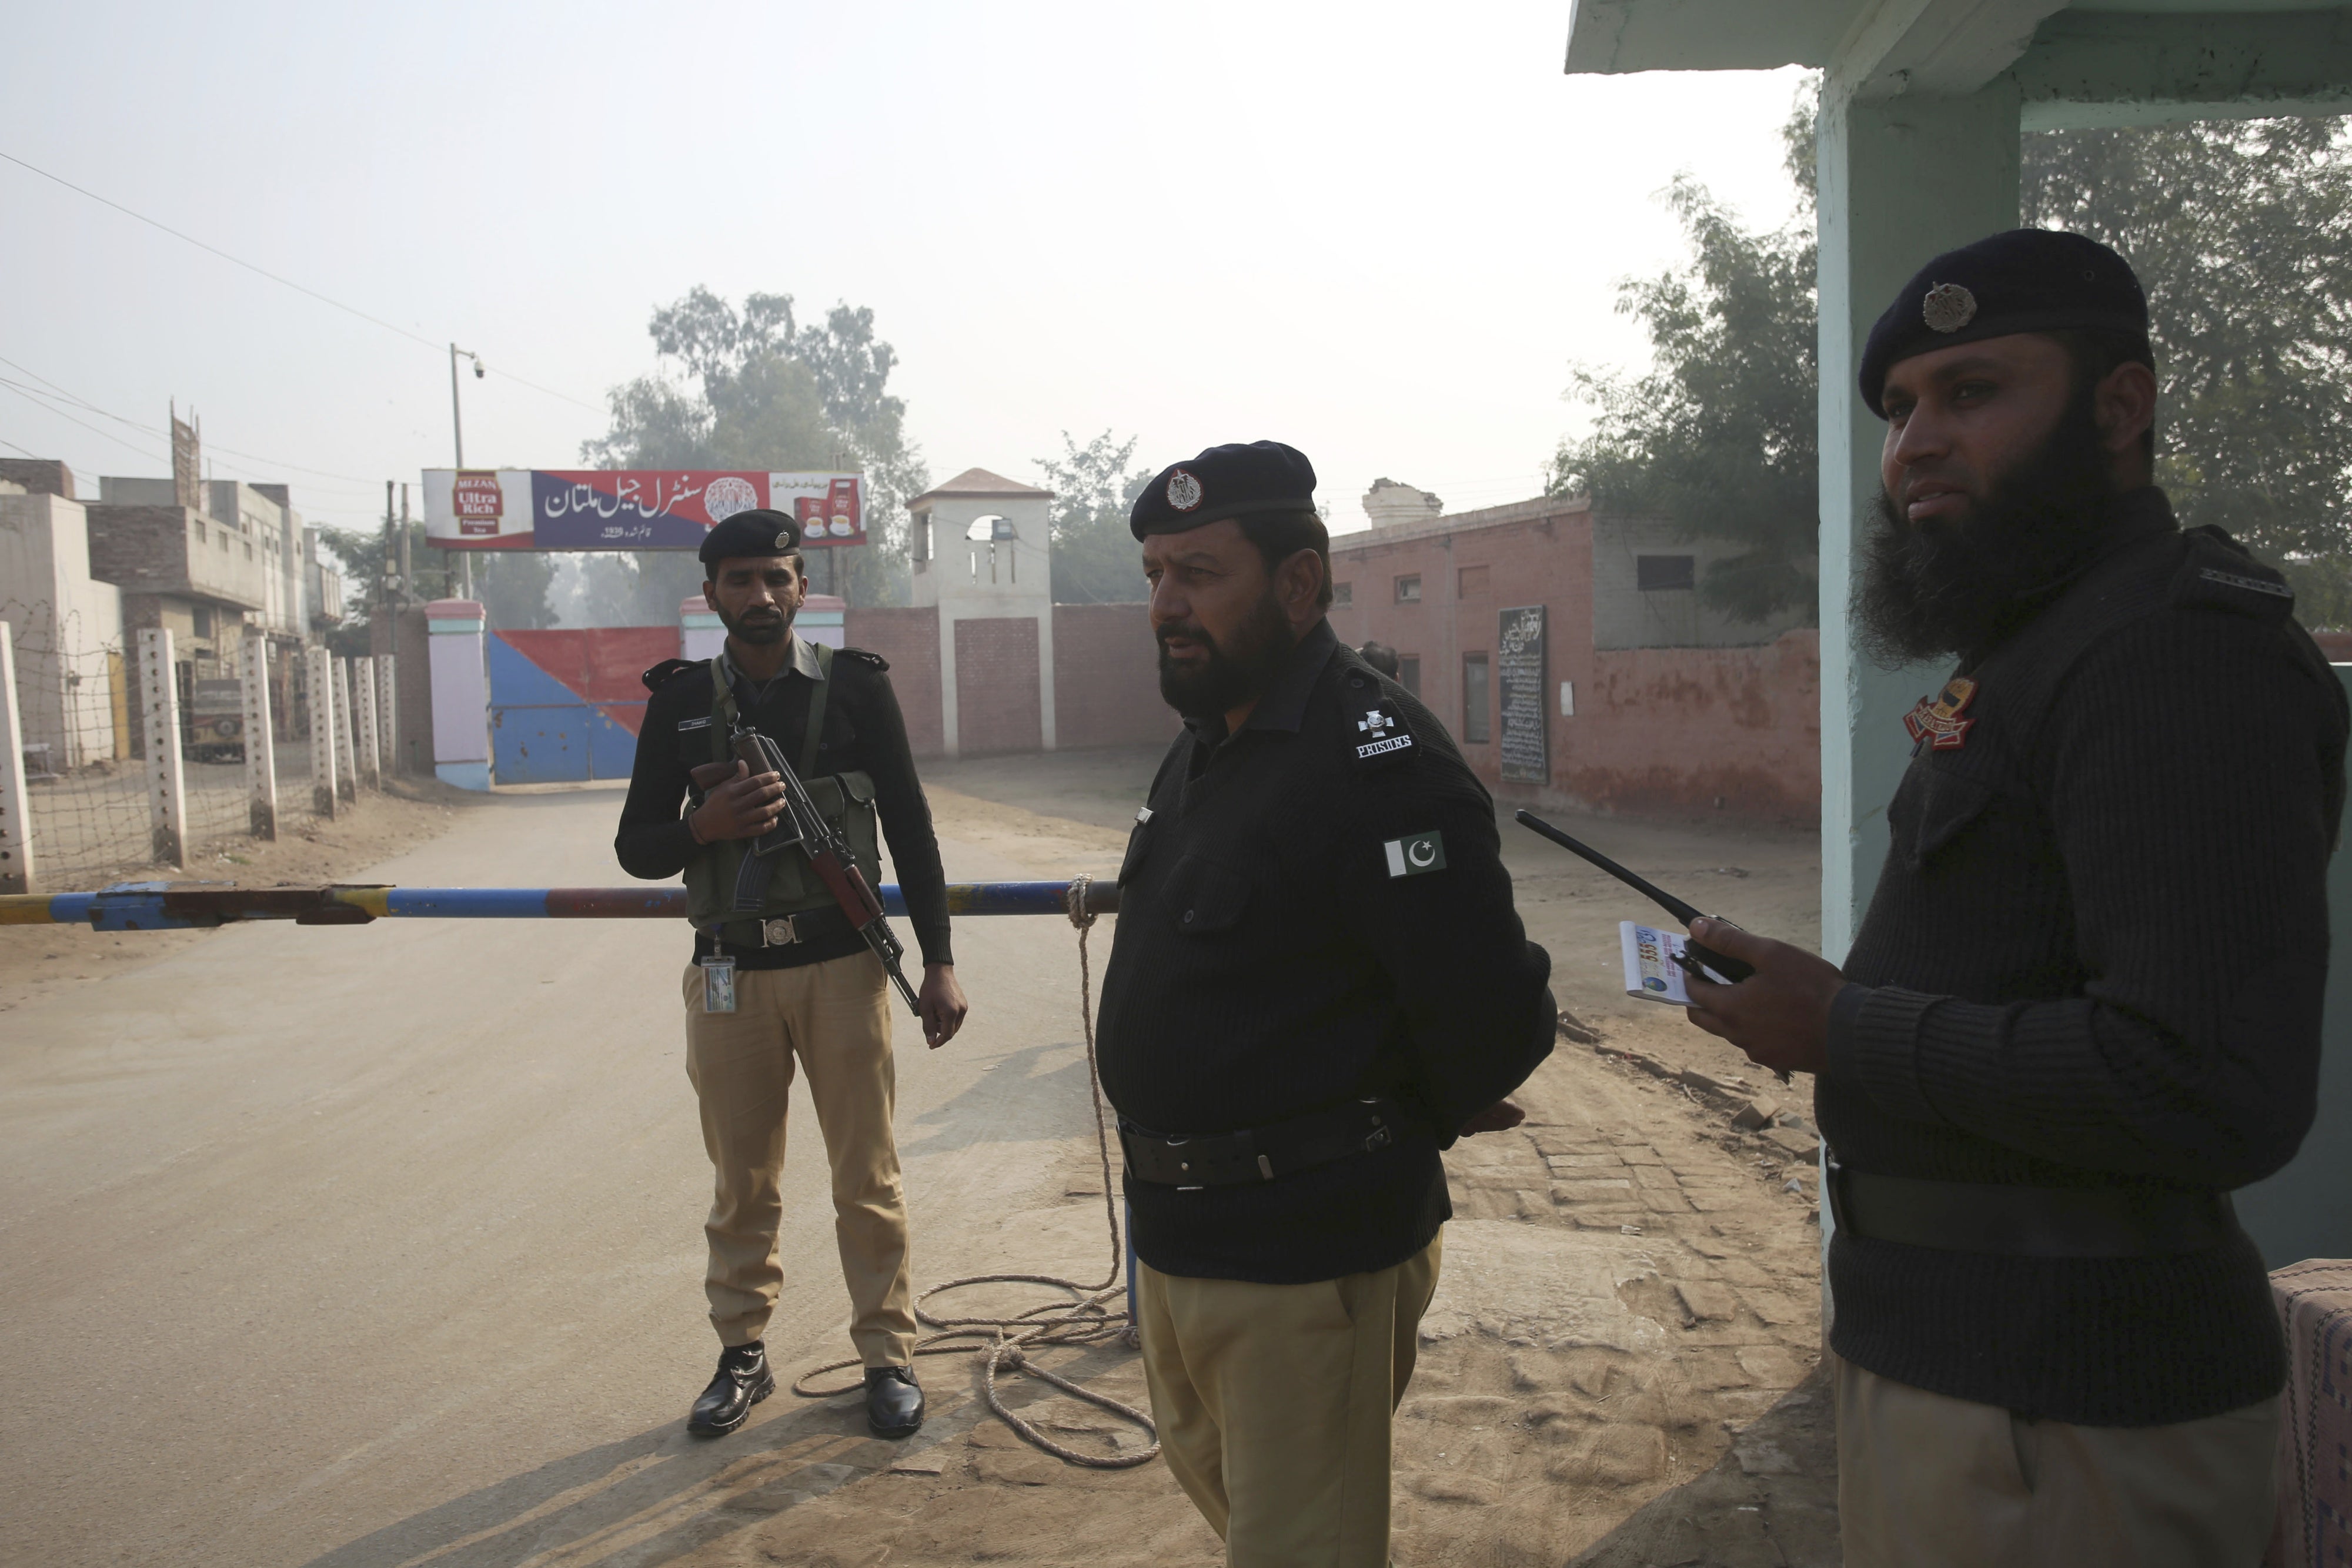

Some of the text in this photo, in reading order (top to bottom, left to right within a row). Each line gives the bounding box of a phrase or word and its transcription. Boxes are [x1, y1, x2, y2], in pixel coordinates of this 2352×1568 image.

[458, 479, 497, 490] MEZAN
[459, 492, 497, 504] Ultra
[544, 474, 702, 519] سنٹرل جیل ملتان
[463, 503, 494, 514] Rich
[1356, 735, 1412, 758] PRISONS
